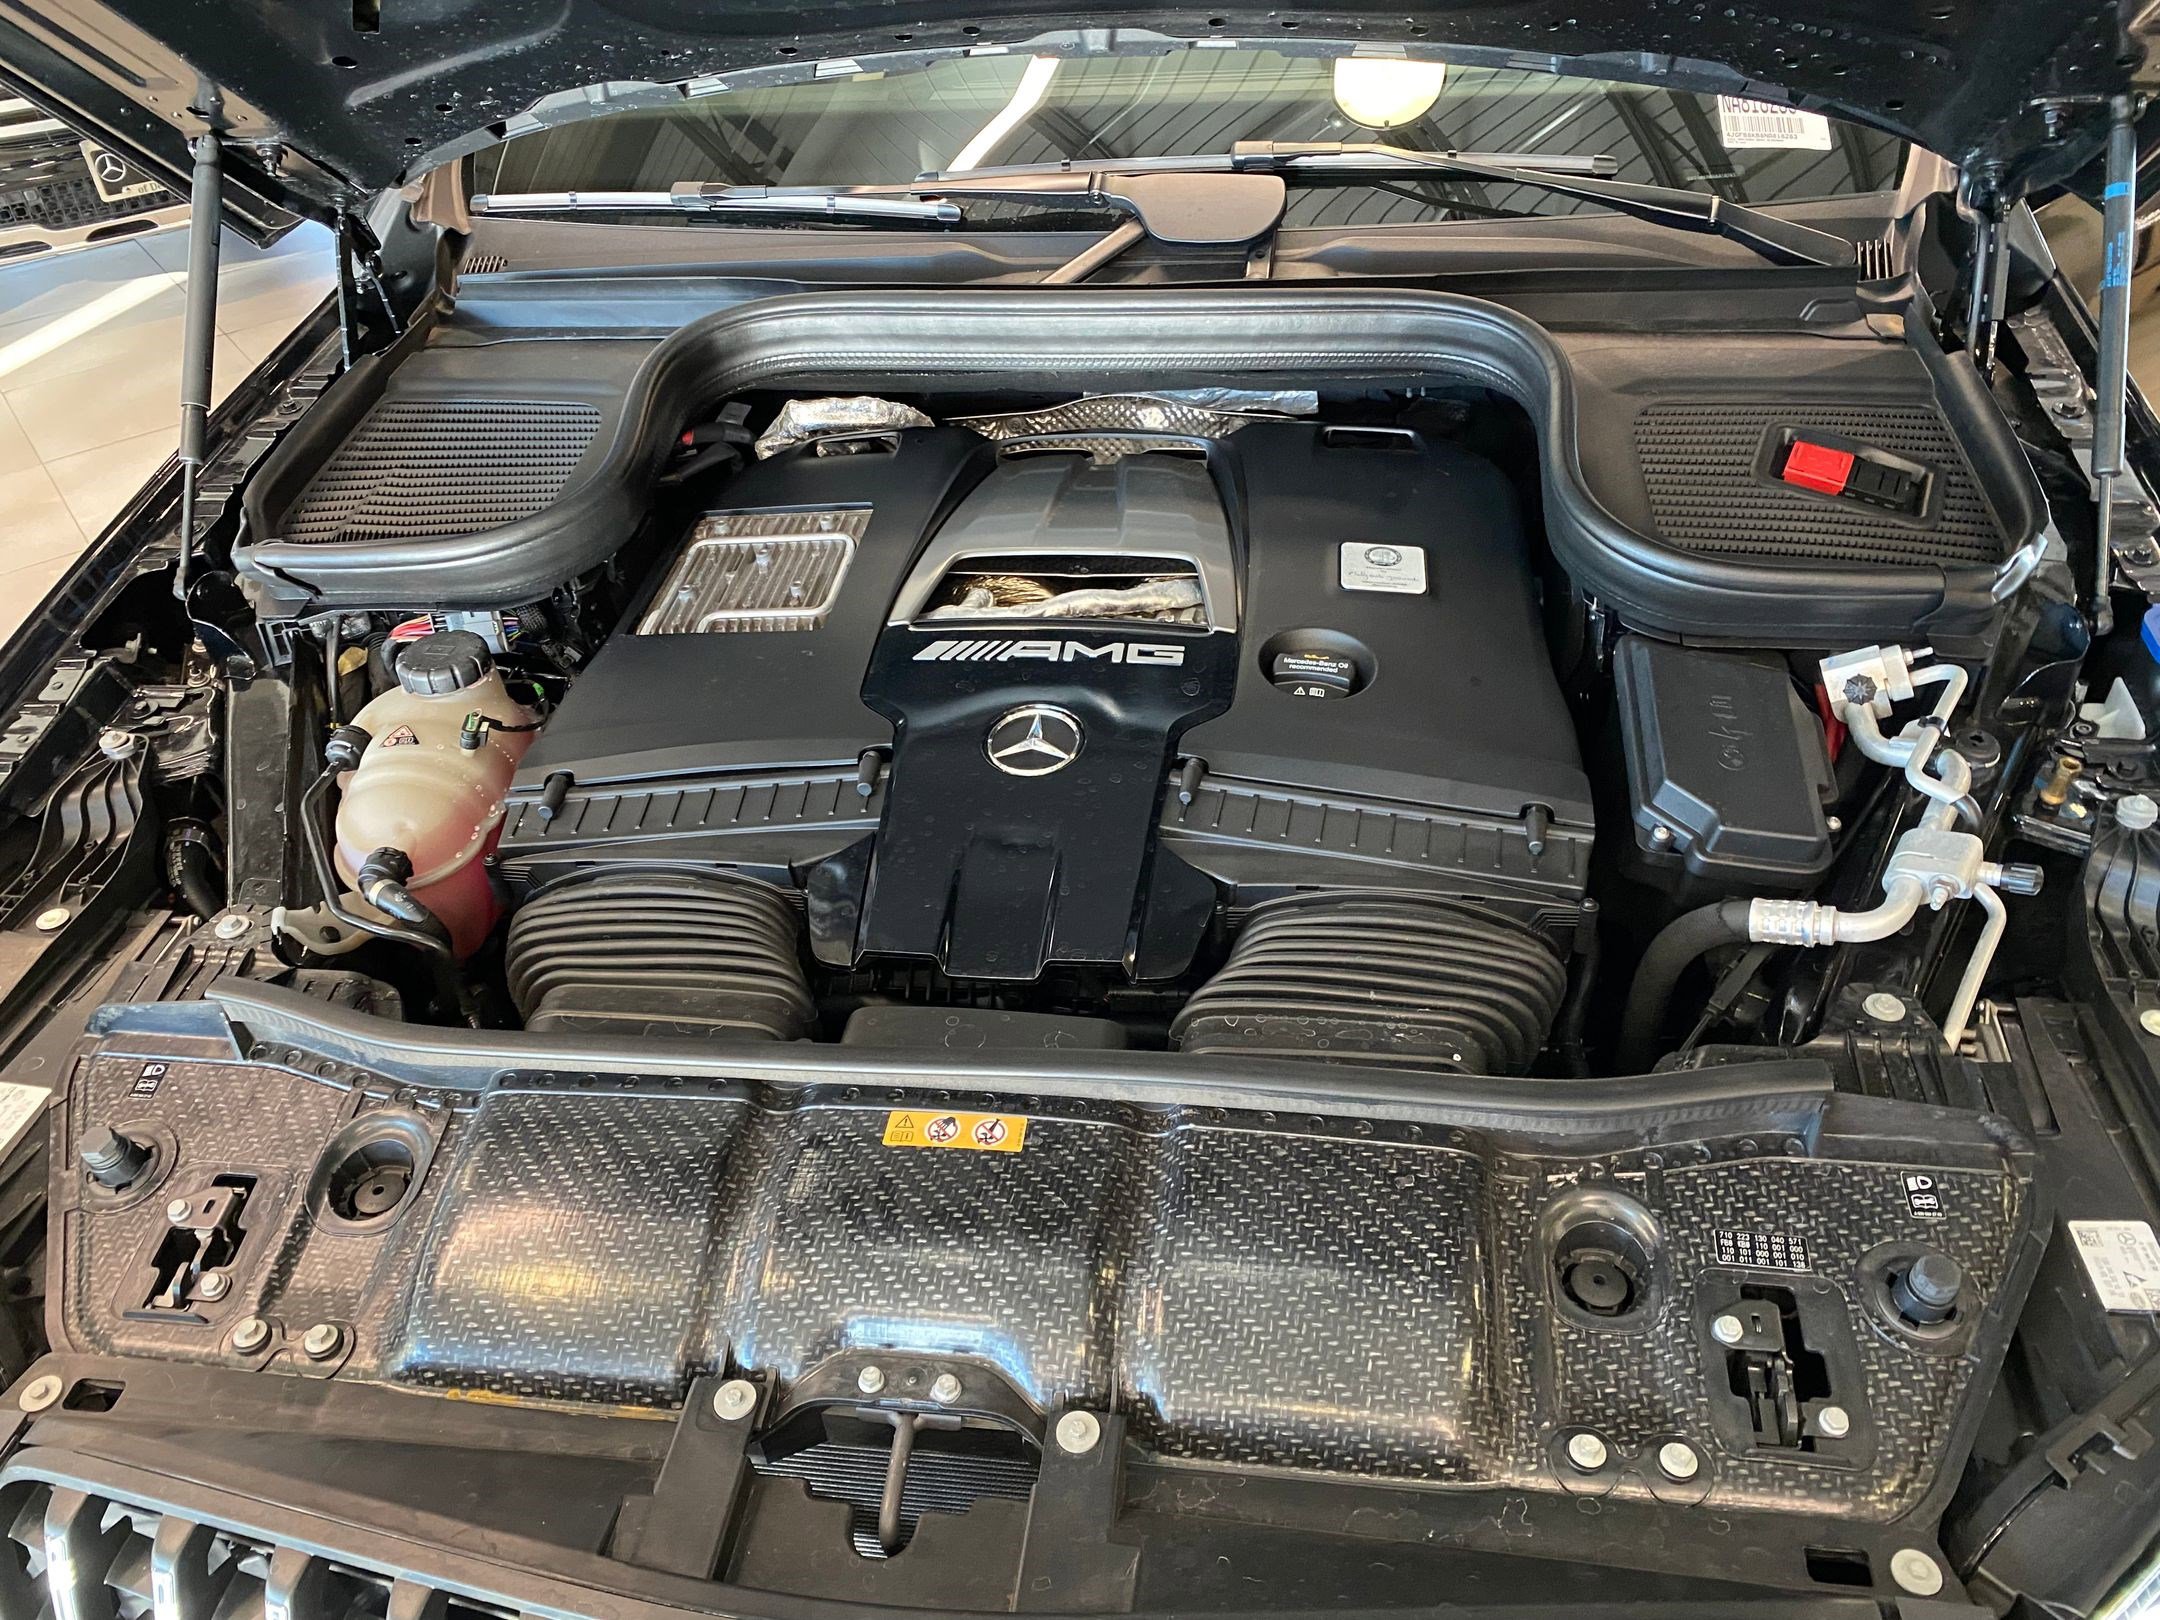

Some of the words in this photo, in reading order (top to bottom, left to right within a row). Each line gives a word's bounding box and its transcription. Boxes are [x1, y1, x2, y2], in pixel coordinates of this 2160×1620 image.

[138, 184, 148, 193] of
[997, 641, 1185, 666] AMG
[1284, 657, 1337, 668] Mercedes-Benz
[1289, 664, 1338, 673] recommended
[1719, 1231, 1732, 1239] 710
[1755, 1234, 1767, 1242] 130
[1771, 1236, 1784, 1244] 040
[1788, 1238, 1801, 1246] 571
[1756, 1242, 1768, 1250] 110
[1789, 1245, 1803, 1253] 000
[1739, 1248, 1751, 1256] 101
[1791, 1253, 1804, 1261] 010
[1775, 1259, 1787, 1267] 101
